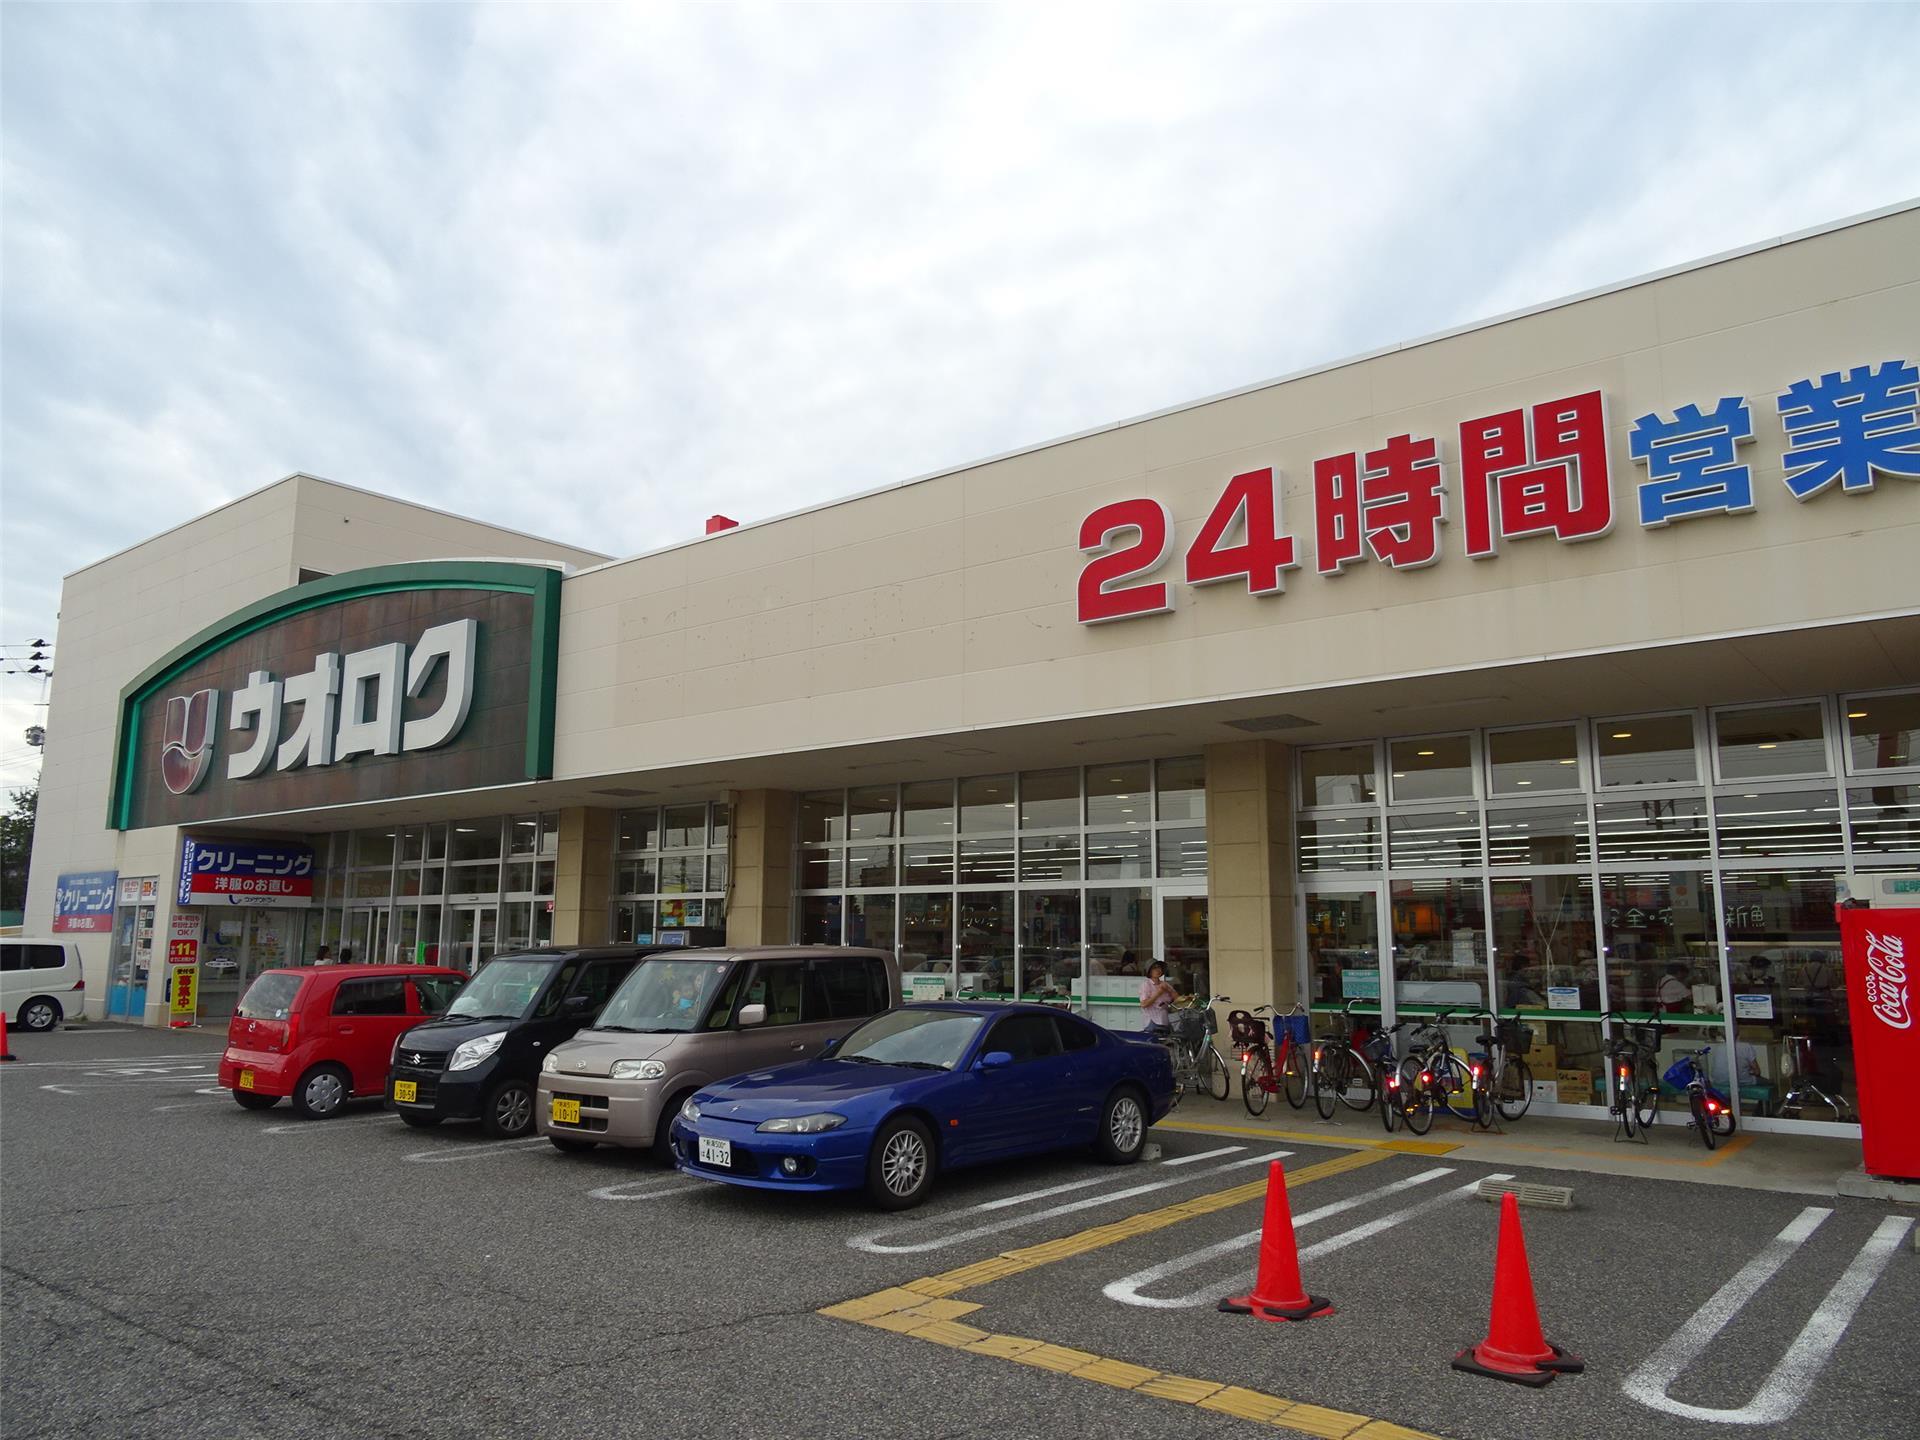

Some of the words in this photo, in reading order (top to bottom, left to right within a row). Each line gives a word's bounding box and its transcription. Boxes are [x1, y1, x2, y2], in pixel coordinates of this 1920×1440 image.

[1077, 357, 1920, 626] 24時間営業
[227, 618, 478, 780] ウオロク
[196, 849, 313, 876] クリーニング
[215, 876, 293, 893] 洋服のお直し
[62, 886, 115, 912] クリーニング
[1865, 929, 1911, 1029] Coca-Cola
[558, 1108, 577, 1122] 10-17
[706, 1147, 730, 1165] 41-32
